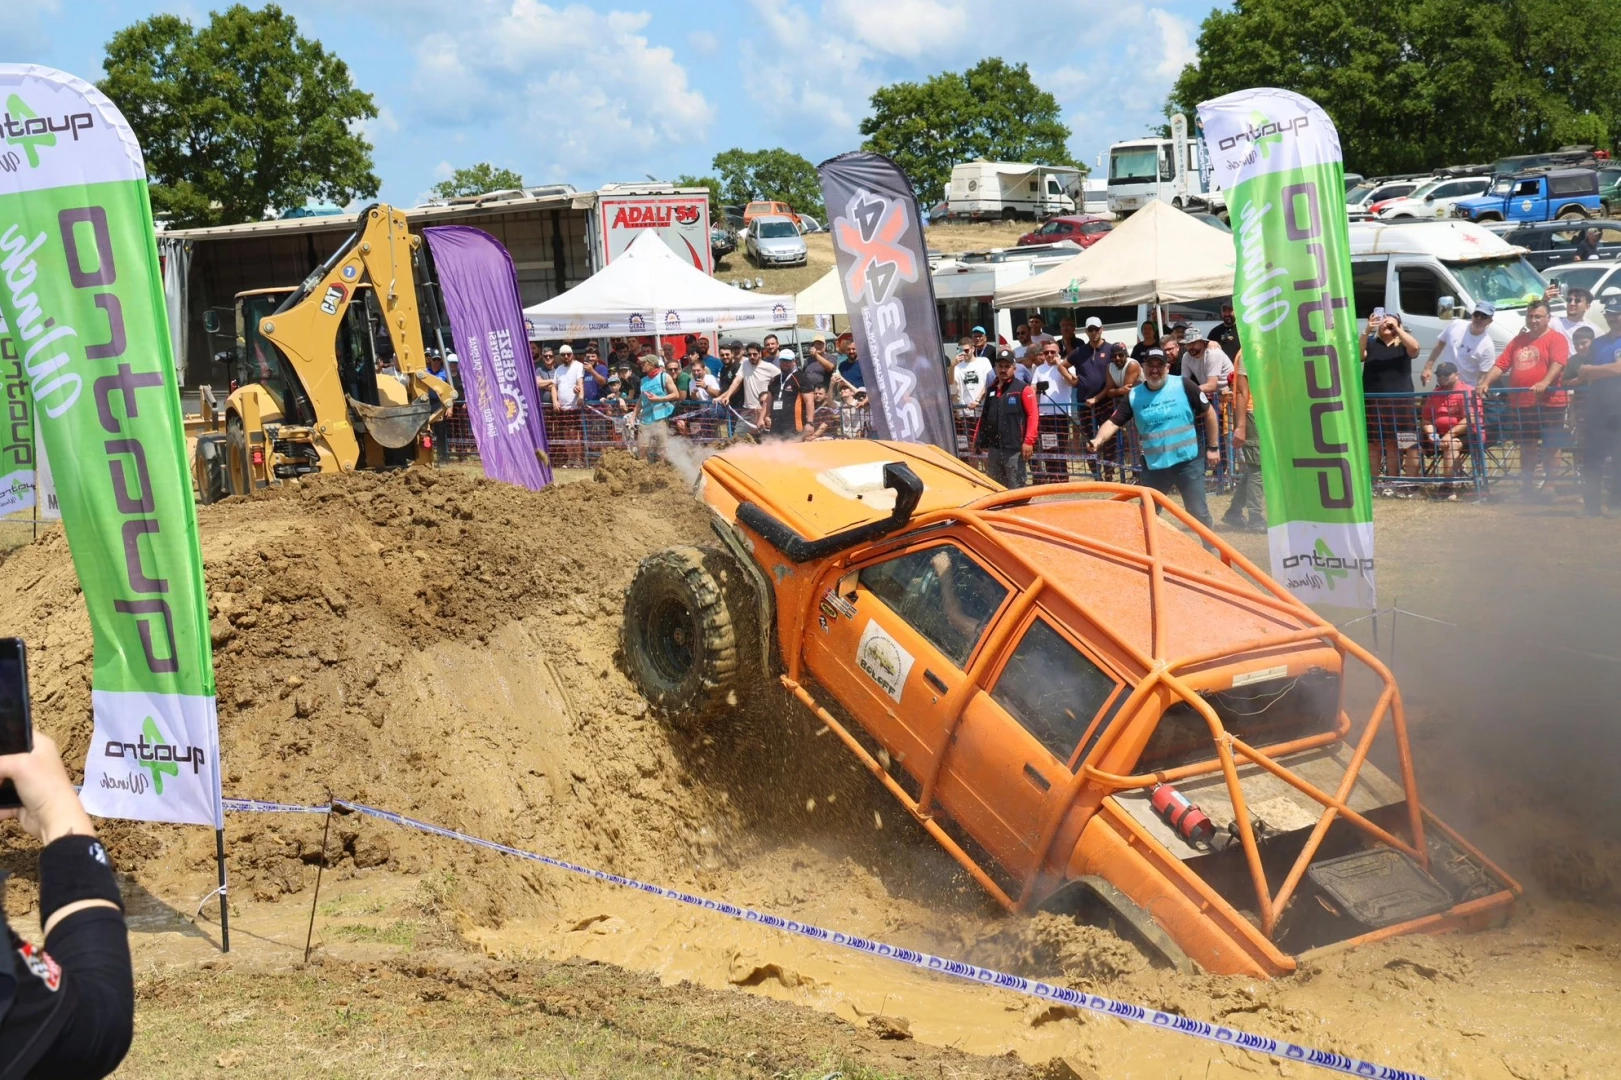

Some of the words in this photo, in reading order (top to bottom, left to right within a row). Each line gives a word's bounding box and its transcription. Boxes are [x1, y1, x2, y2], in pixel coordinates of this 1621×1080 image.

[612, 205, 672, 229] ADALI
[346, 267, 352, 276] 7
[320, 286, 343, 315] CAT
